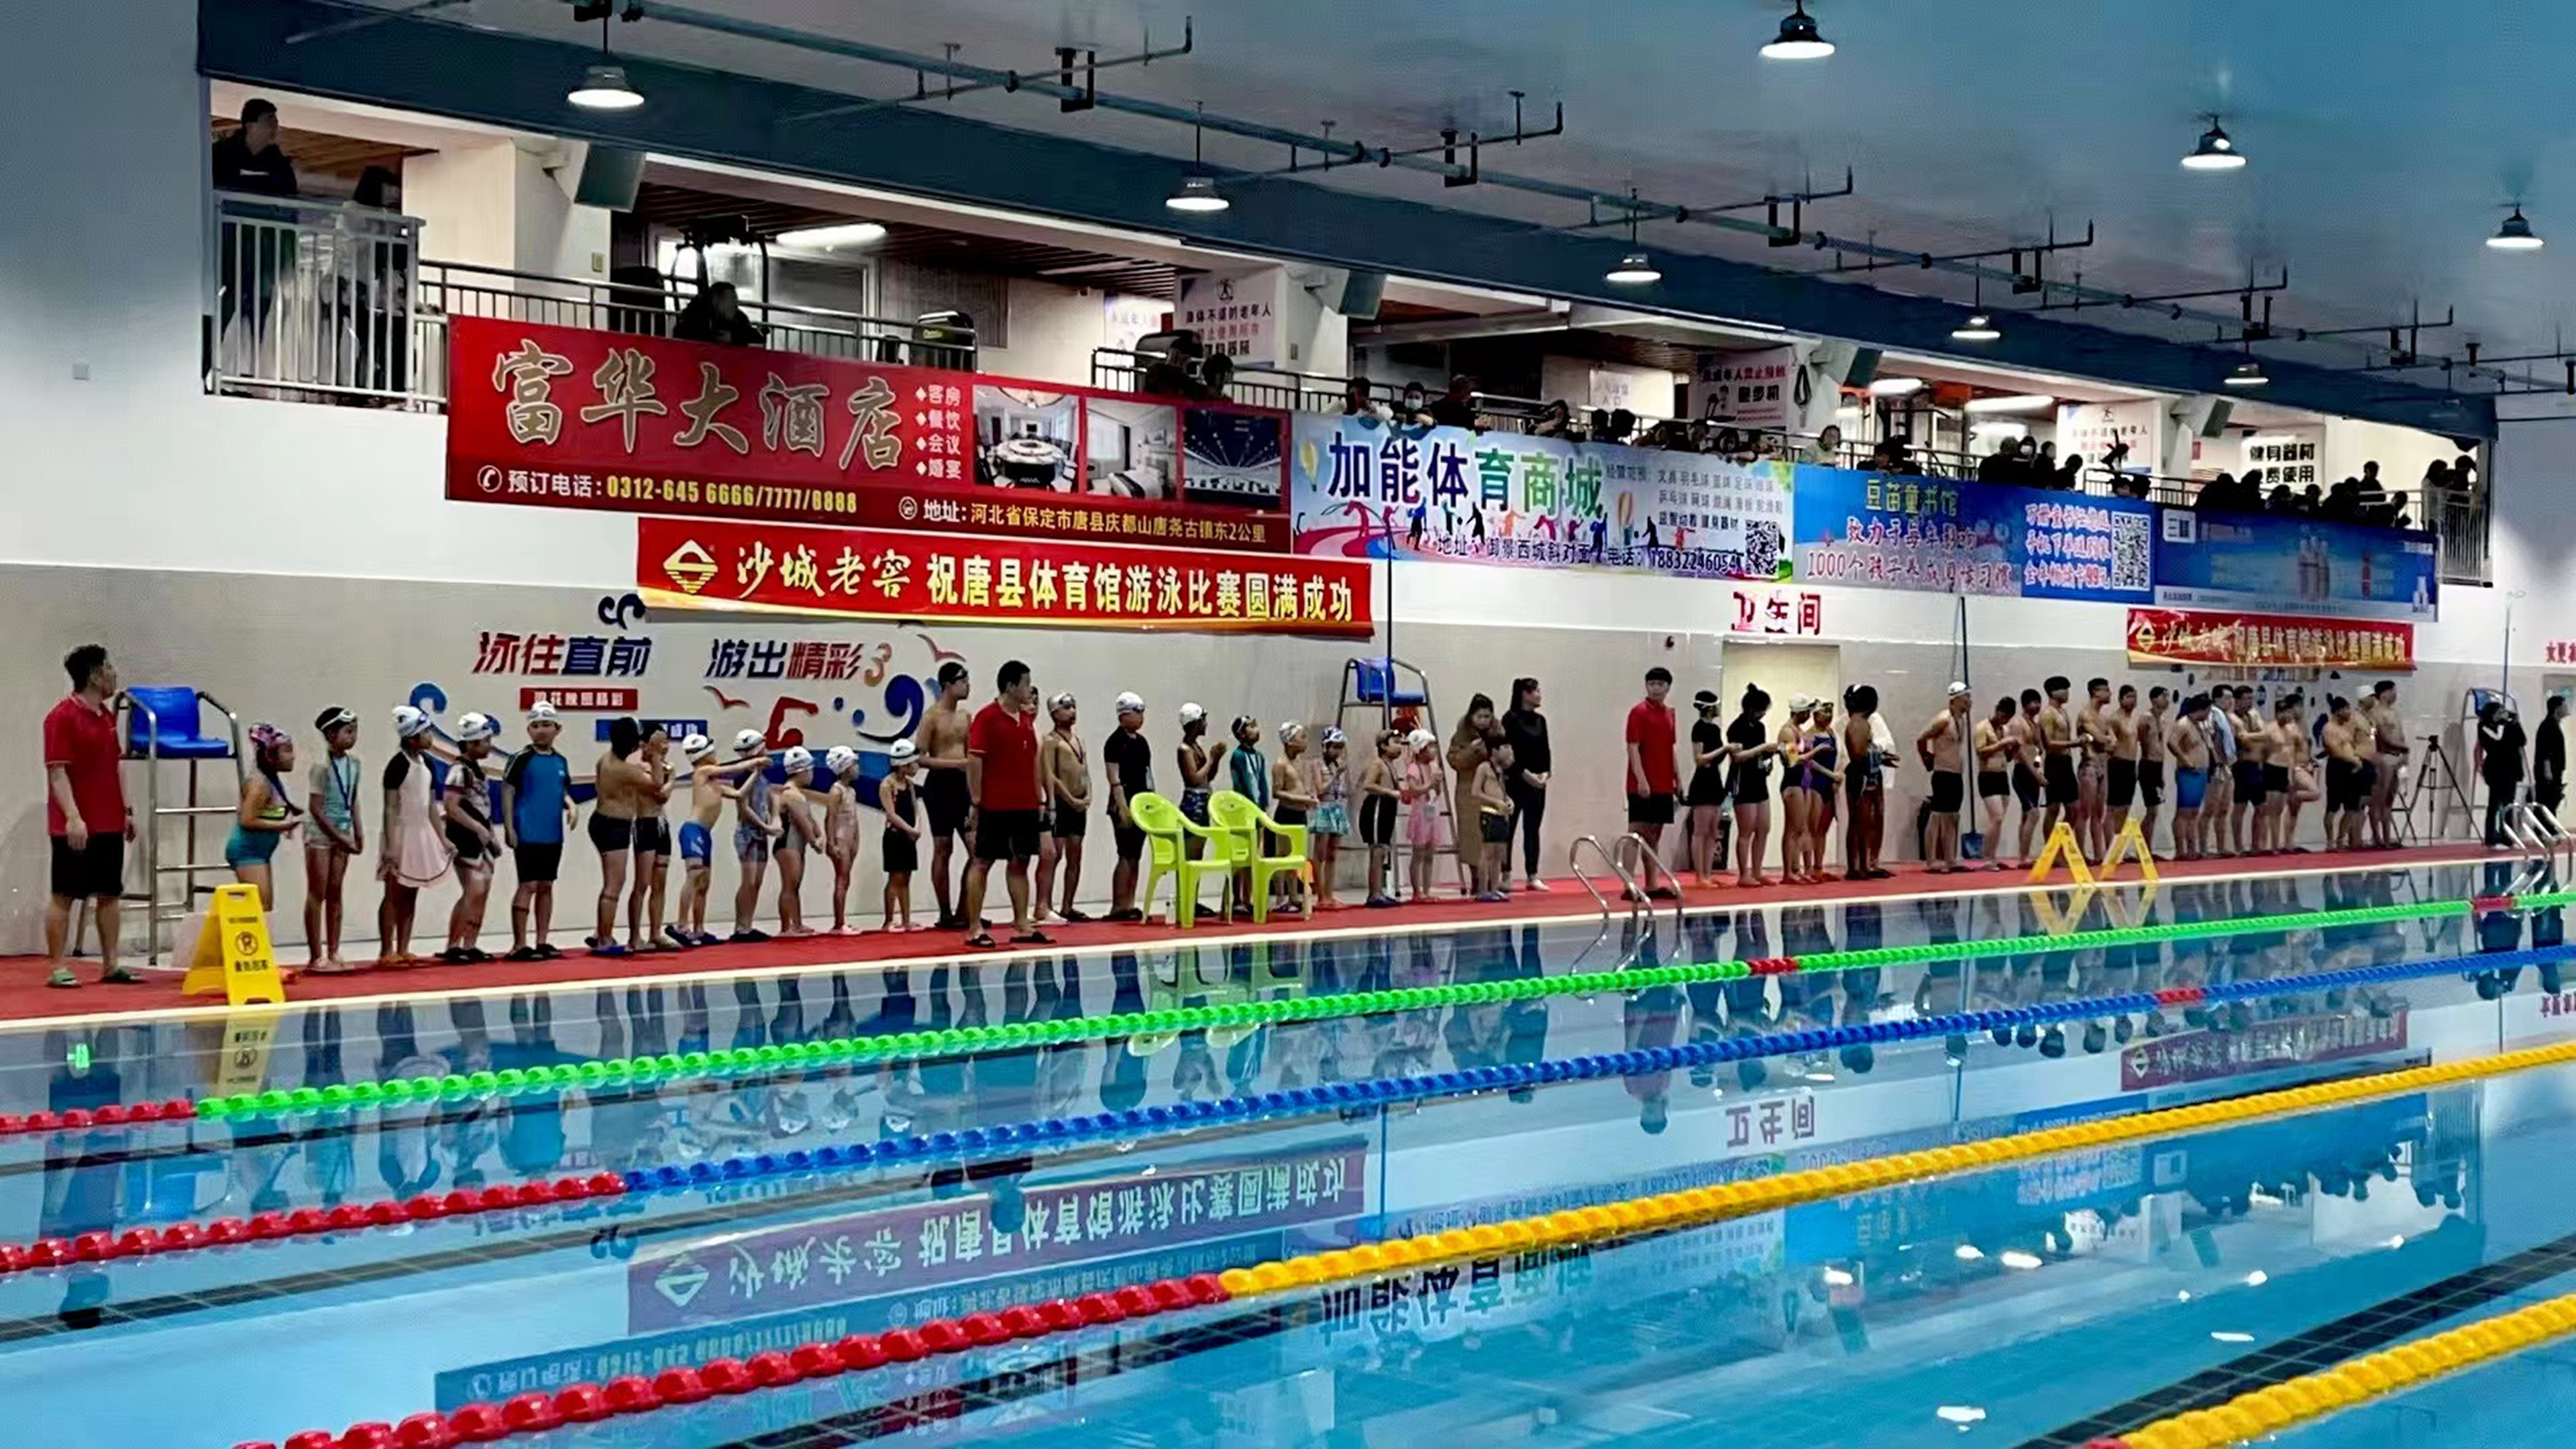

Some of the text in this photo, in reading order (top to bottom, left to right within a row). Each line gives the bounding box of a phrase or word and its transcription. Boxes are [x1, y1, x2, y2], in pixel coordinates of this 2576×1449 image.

[492, 339, 903, 470] 富华大酒店
[928, 385, 961, 407] 客房
[928, 434, 961, 455] 会议
[1328, 431, 1603, 517] 加能体育商城
[737, 541, 1353, 623] 沙城老窖 祝唐县体育馆游泳比赛圆满成功
[472, 632, 864, 681] 泳往直前 游出精彩
